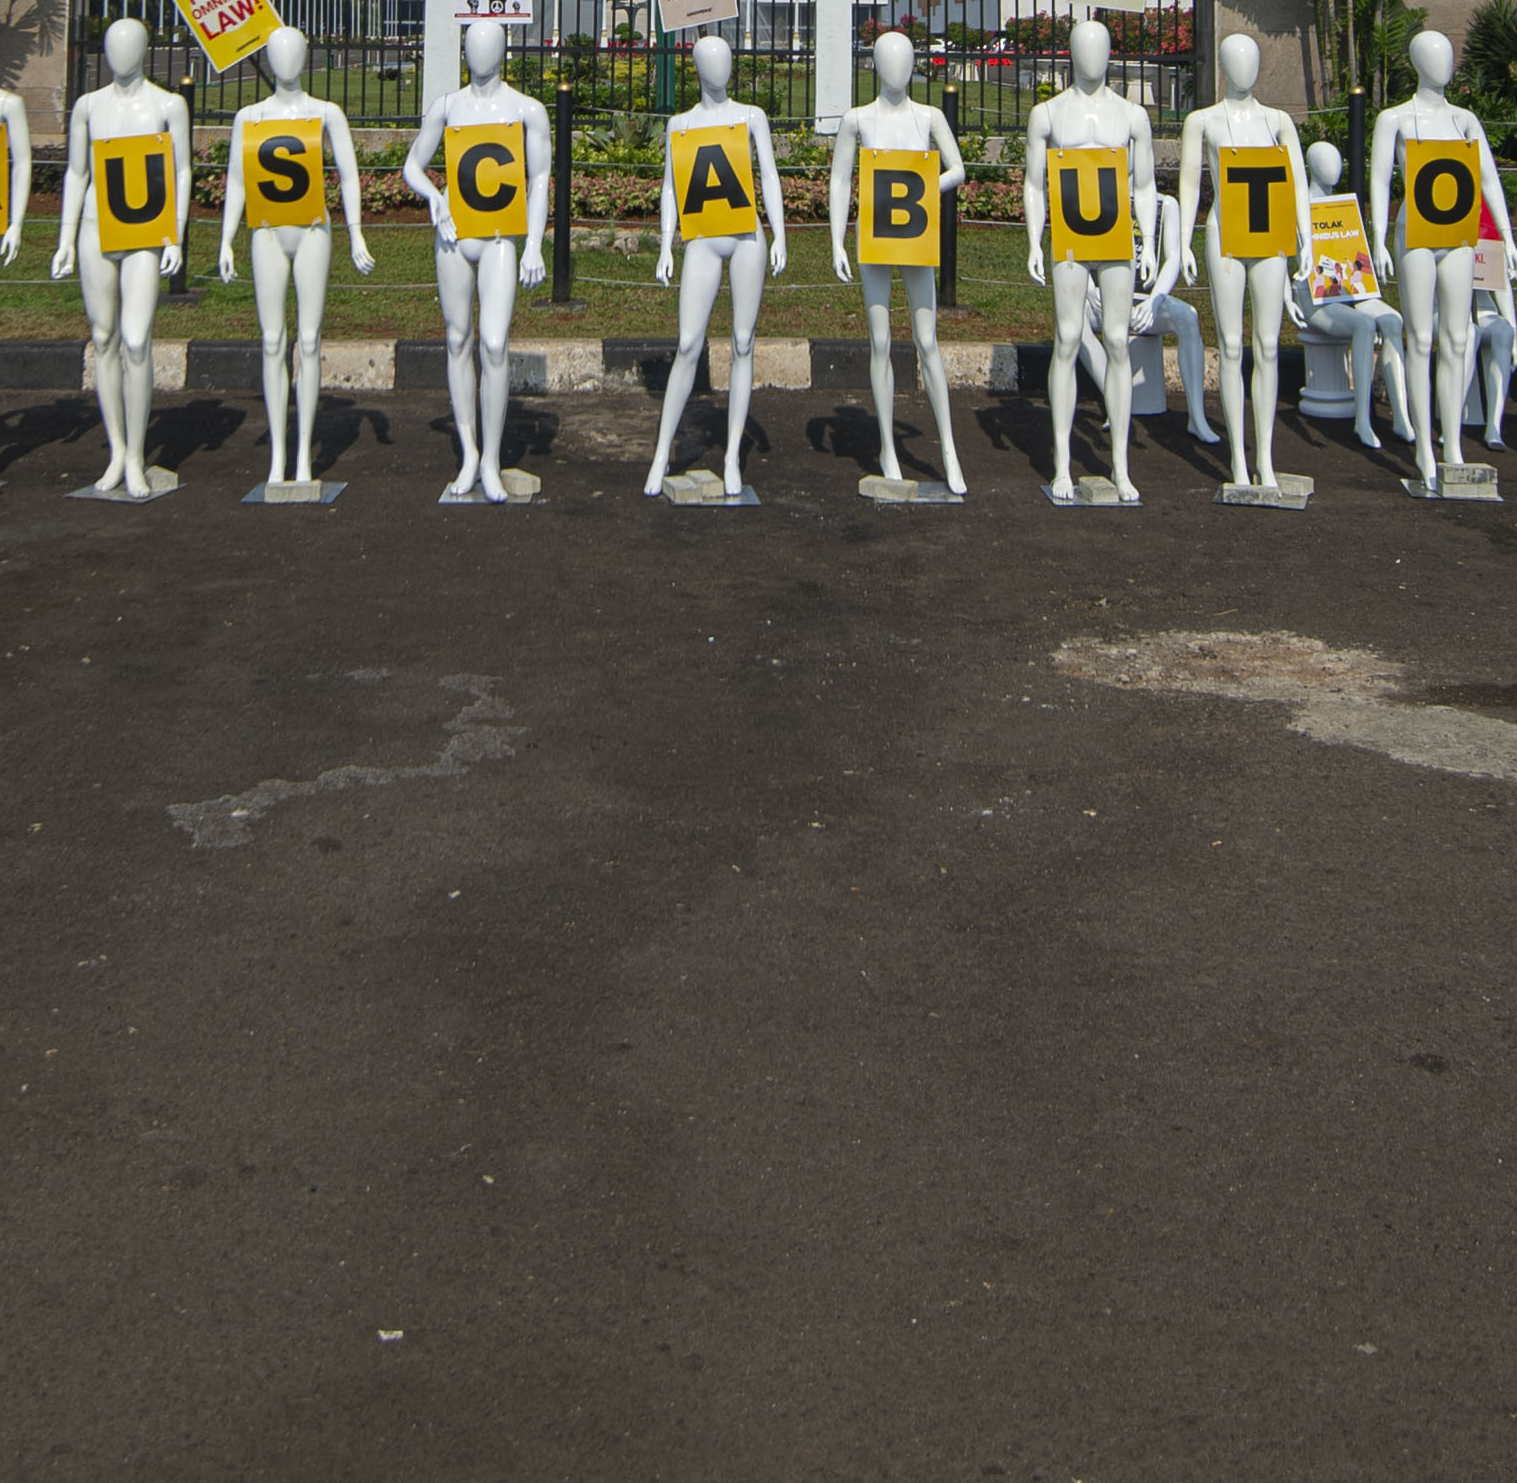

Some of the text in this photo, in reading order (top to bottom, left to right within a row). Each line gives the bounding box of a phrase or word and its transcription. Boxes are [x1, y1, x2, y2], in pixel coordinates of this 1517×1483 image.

[105, 153, 166, 224] U
[257, 141, 310, 203] S
[457, 142, 517, 212] C
[682, 144, 751, 215] A
[873, 169, 928, 239] B
[1059, 167, 1119, 236] U
[1227, 166, 1287, 233] T
[1413, 158, 1475, 226] O
[1313, 220, 1343, 230] TOLAK
[1340, 229, 1360, 237] LAW
